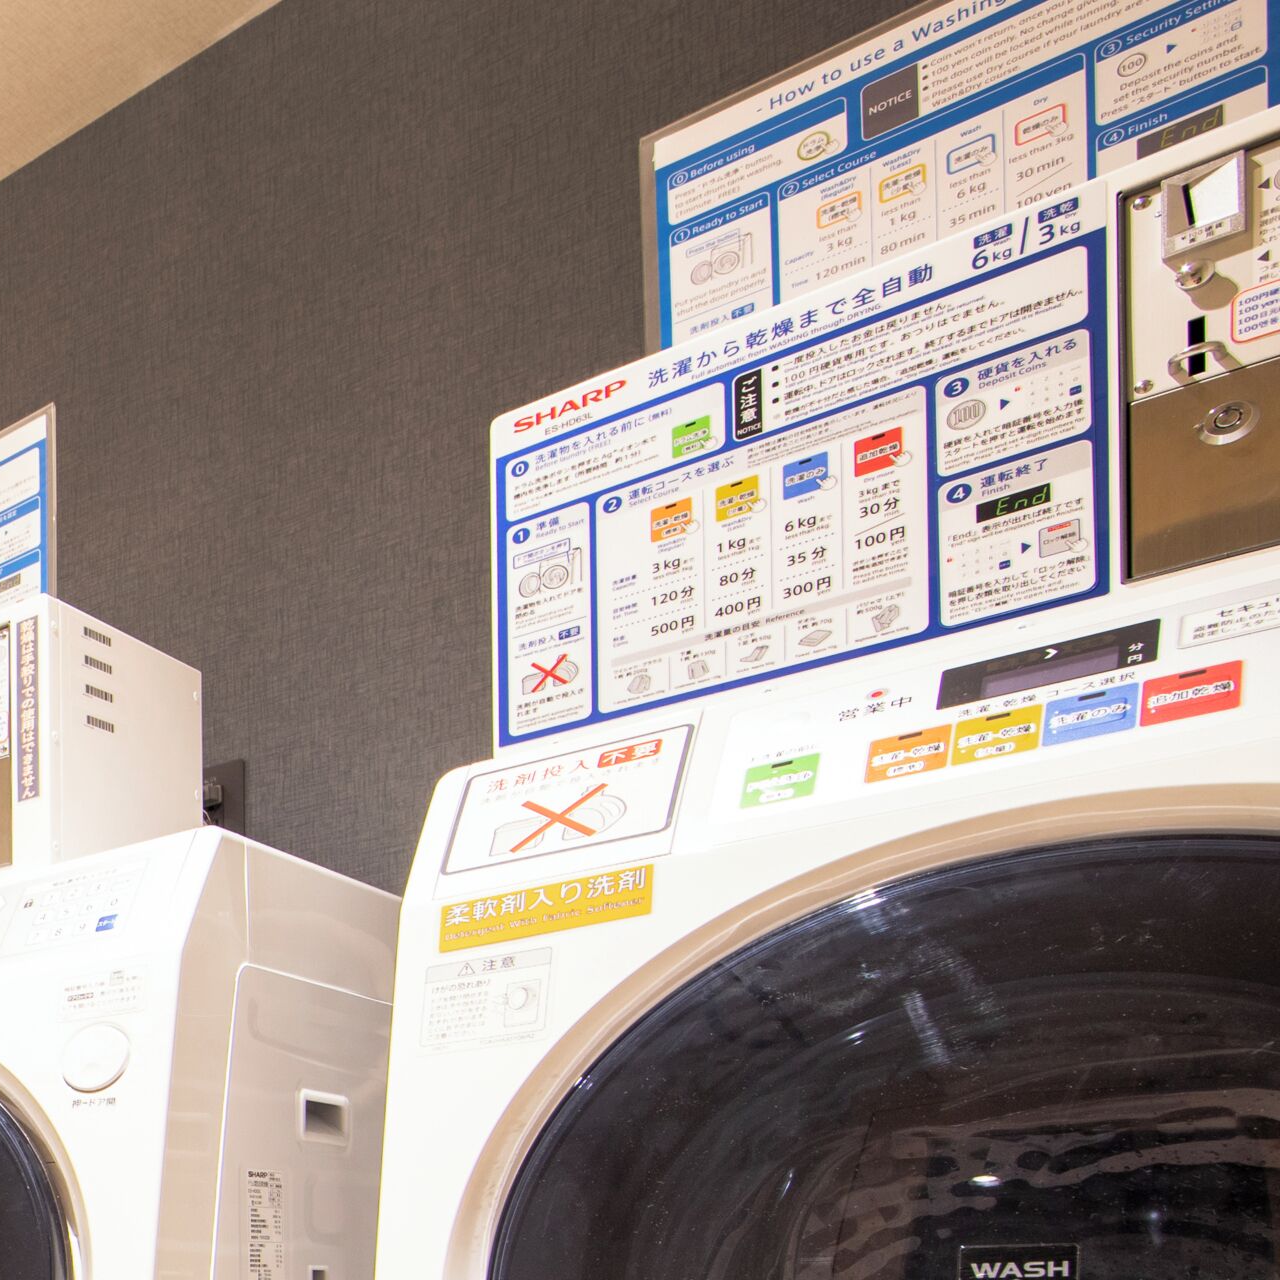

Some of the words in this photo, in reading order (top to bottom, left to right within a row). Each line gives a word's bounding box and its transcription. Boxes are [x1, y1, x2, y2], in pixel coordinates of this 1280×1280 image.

[1107, 43, 1116, 53] 3
[1126, 14, 1181, 45] Security
[769, 79, 815, 110] How
[822, 68, 842, 86] to
[850, 50, 886, 73] use
[893, 39, 904, 52] a
[868, 90, 912, 116] NOTICE
[1109, 132, 1118, 142] 4
[1129, 112, 1168, 136] Finish
[1159, 108, 1221, 149] End
[690, 159, 724, 178] Before
[729, 143, 755, 165] using
[787, 184, 795, 195] 2
[802, 169, 836, 188] Select
[838, 150, 877, 173] Course
[692, 220, 724, 235] Ready
[726, 210, 736, 220] to
[740, 199, 763, 214] Start
[977, 226, 1010, 245] 洗濯
[648, 262, 933, 388] 洗濯から乾燥まで全自動
[978, 338, 1078, 381] 硬貨を入れる
[978, 372, 1016, 390] Deposit
[1019, 361, 1047, 377] Coins
[514, 379, 627, 434] SHARP
[740, 375, 758, 425] ご注意
[535, 418, 646, 465] 洗濯物を入れる前に
[736, 422, 762, 437] NOTICE
[628, 454, 735, 501] 運転コースを選ぶ
[980, 458, 1049, 488] 運転終了
[981, 482, 1011, 498] Finish
[996, 486, 1048, 517] End
[854, 525, 906, 550] 100円
[783, 576, 832, 600] 300円
[714, 597, 762, 618] 400円
[651, 615, 695, 637] 500円
[838, 695, 913, 723] 営業中
[602, 741, 660, 767] 不要
[444, 868, 648, 927] 柔軟剤入り洗剤
[481, 956, 517, 971] 注意
[970, 1260, 1071, 1279] WASH
